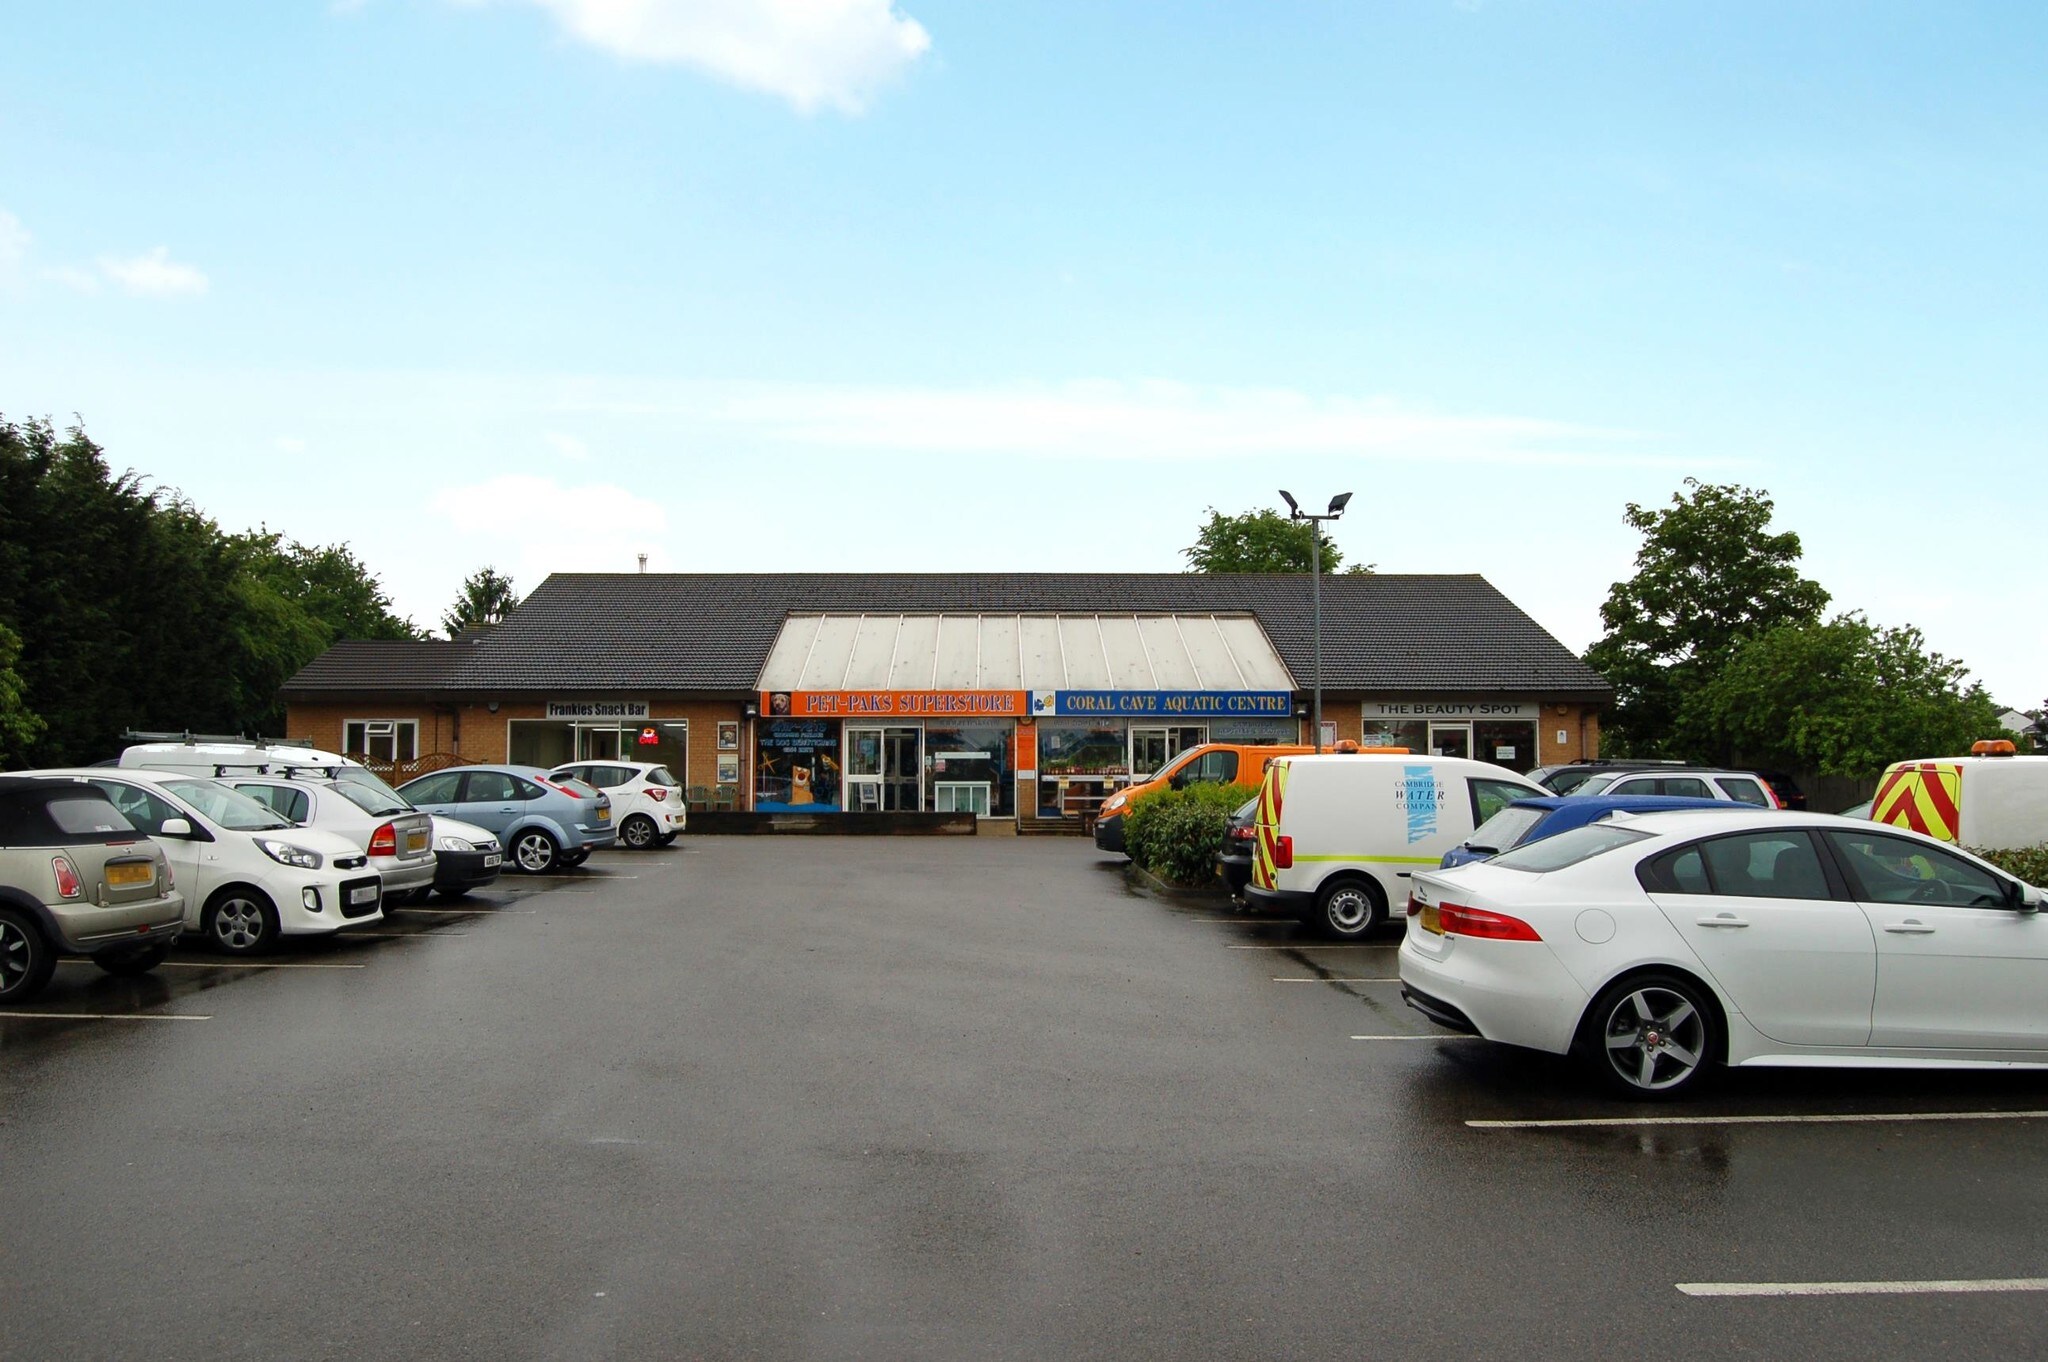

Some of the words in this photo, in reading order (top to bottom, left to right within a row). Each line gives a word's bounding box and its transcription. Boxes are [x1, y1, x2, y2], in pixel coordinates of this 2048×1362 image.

[805, 694, 893, 713] PET-PAKS
[899, 694, 1015, 713] SUPERSTORE
[1066, 695, 1115, 711] CORAL
[1120, 695, 1157, 711] CAVE
[1163, 695, 1225, 712] AQUATIC
[1228, 695, 1286, 711] CENTRE
[1377, 703, 1409, 714] THE
[549, 703, 593, 716] Frankies
[595, 703, 626, 716] Snack
[628, 703, 646, 716] Bar
[1395, 780, 1444, 788] CAMBRIDGE
[1395, 790, 1445, 801] WATER
[1396, 802, 1445, 810] COMPANY
